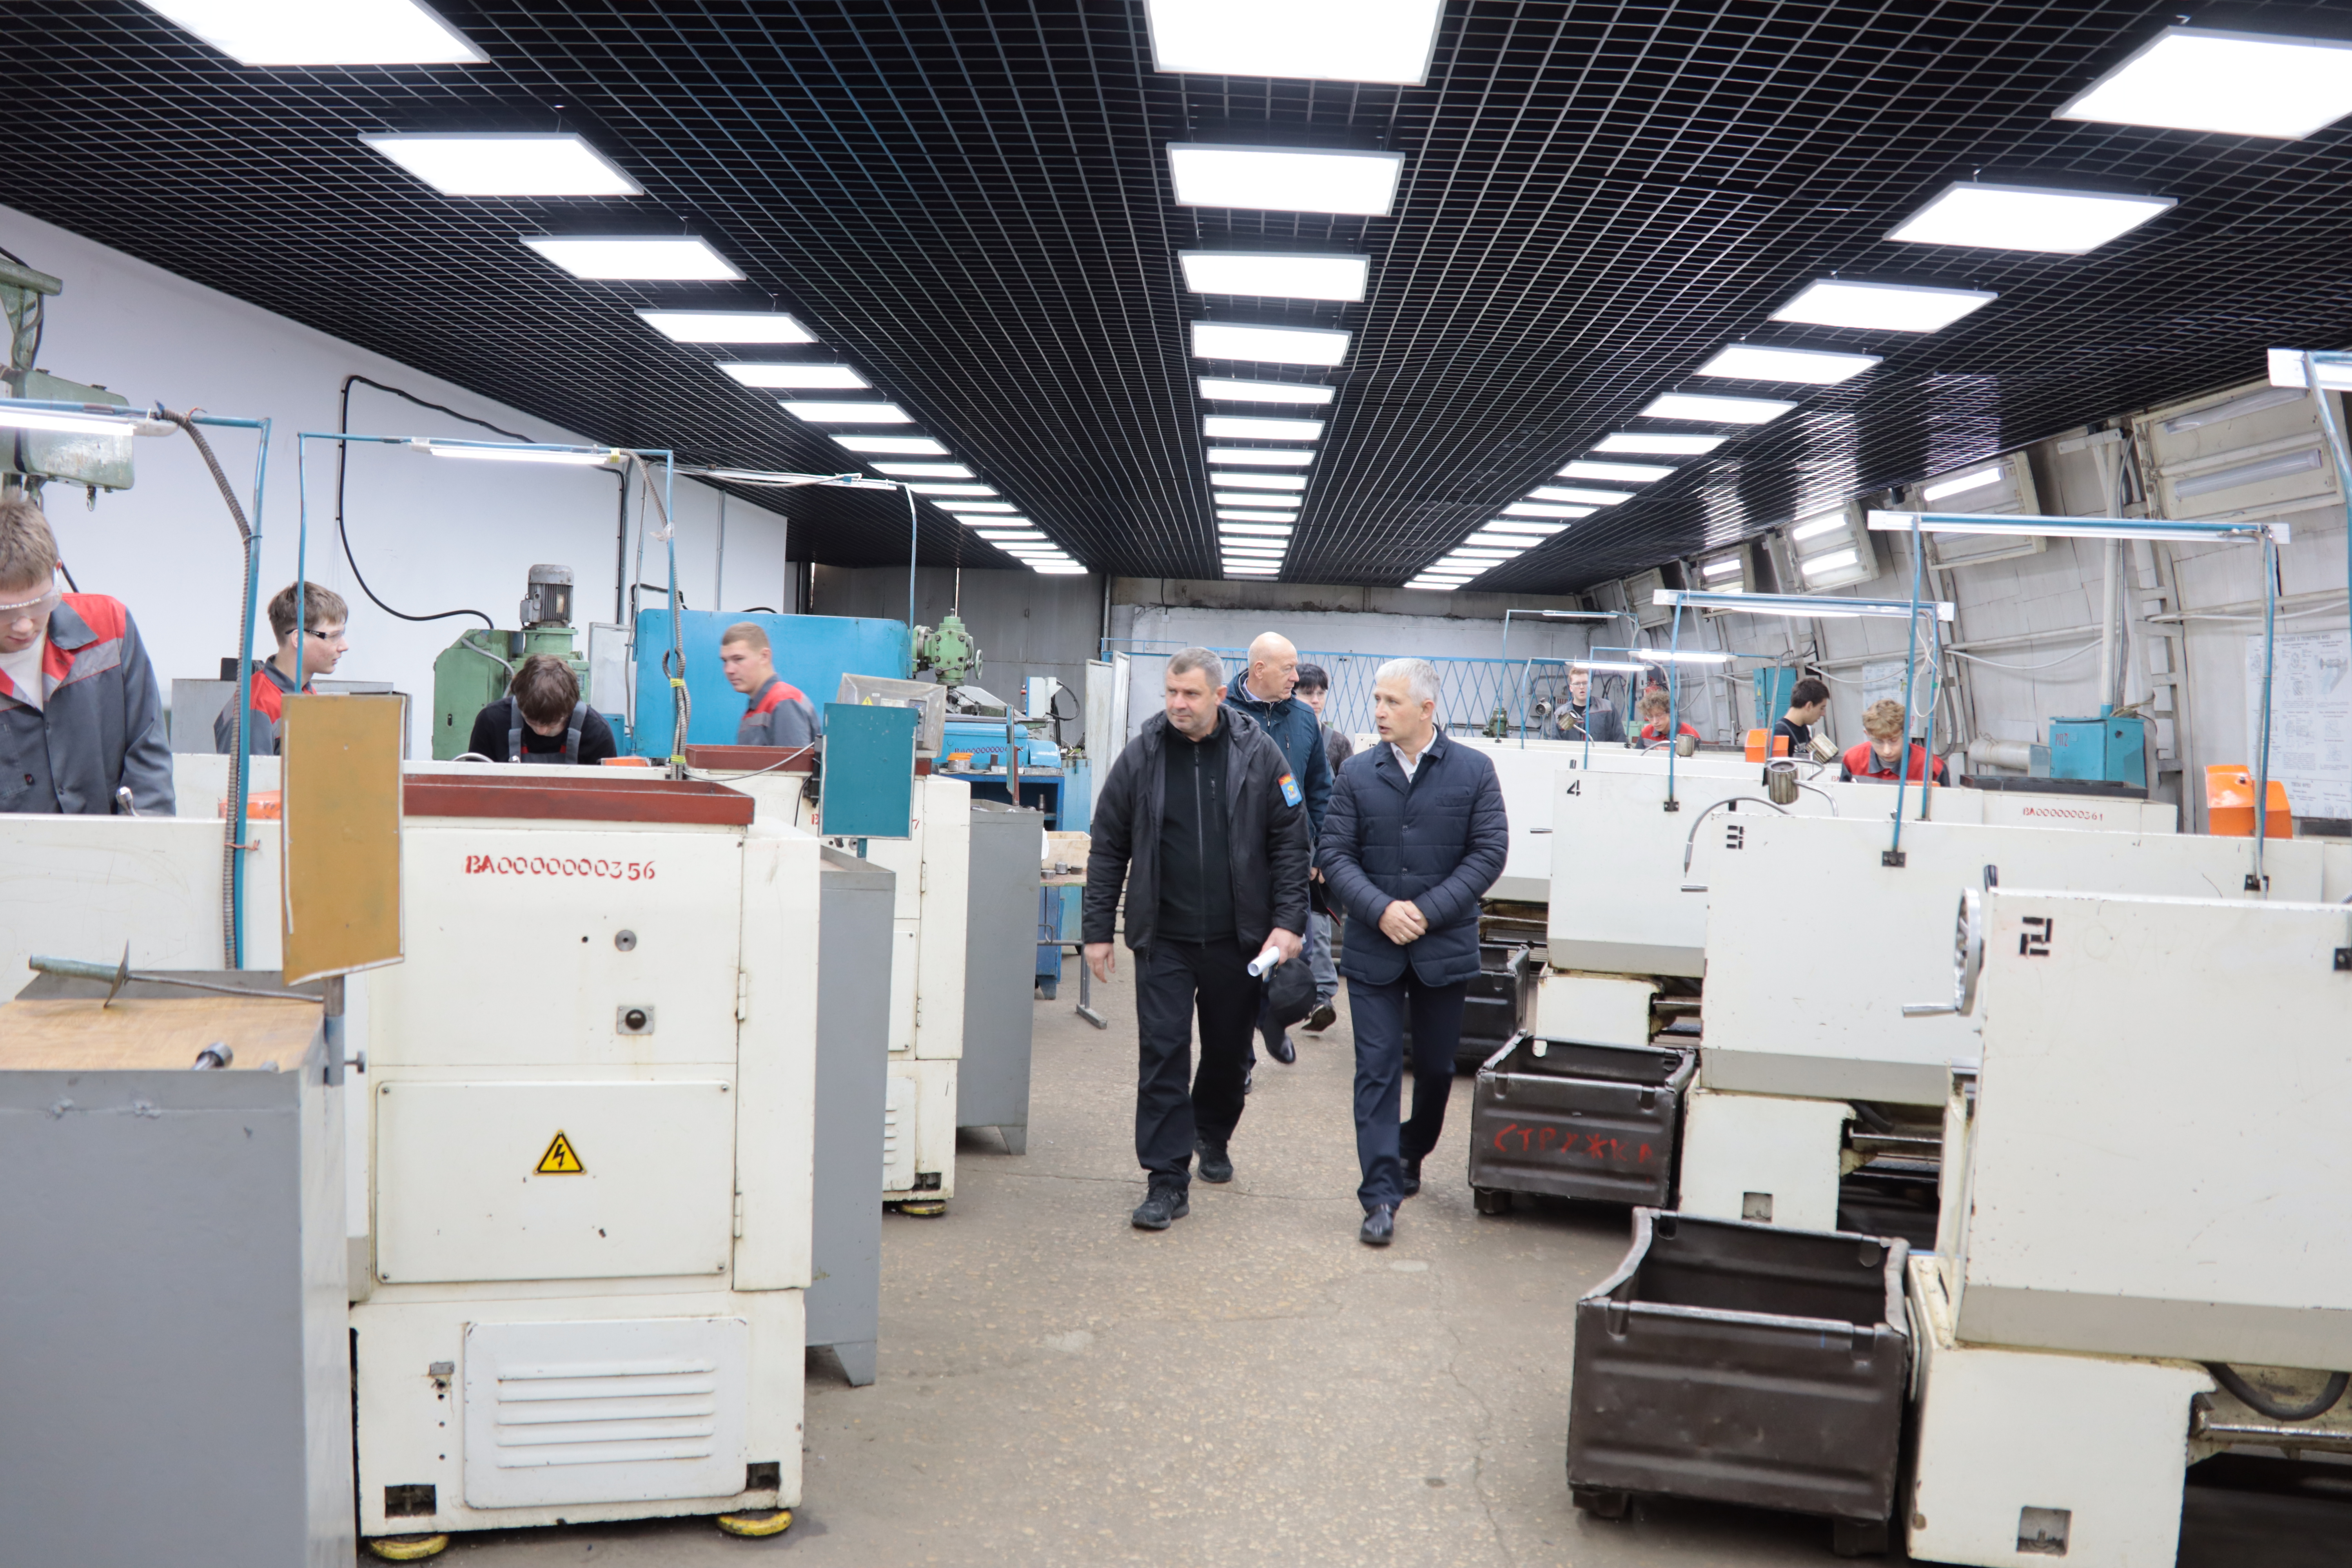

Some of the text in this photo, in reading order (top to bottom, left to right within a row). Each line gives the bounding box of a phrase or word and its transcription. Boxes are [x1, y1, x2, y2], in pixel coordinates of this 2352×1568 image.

[1567, 779, 1581, 797] 4
[1726, 825, 1744, 849] 3
[2019, 916, 2053, 956] 2
